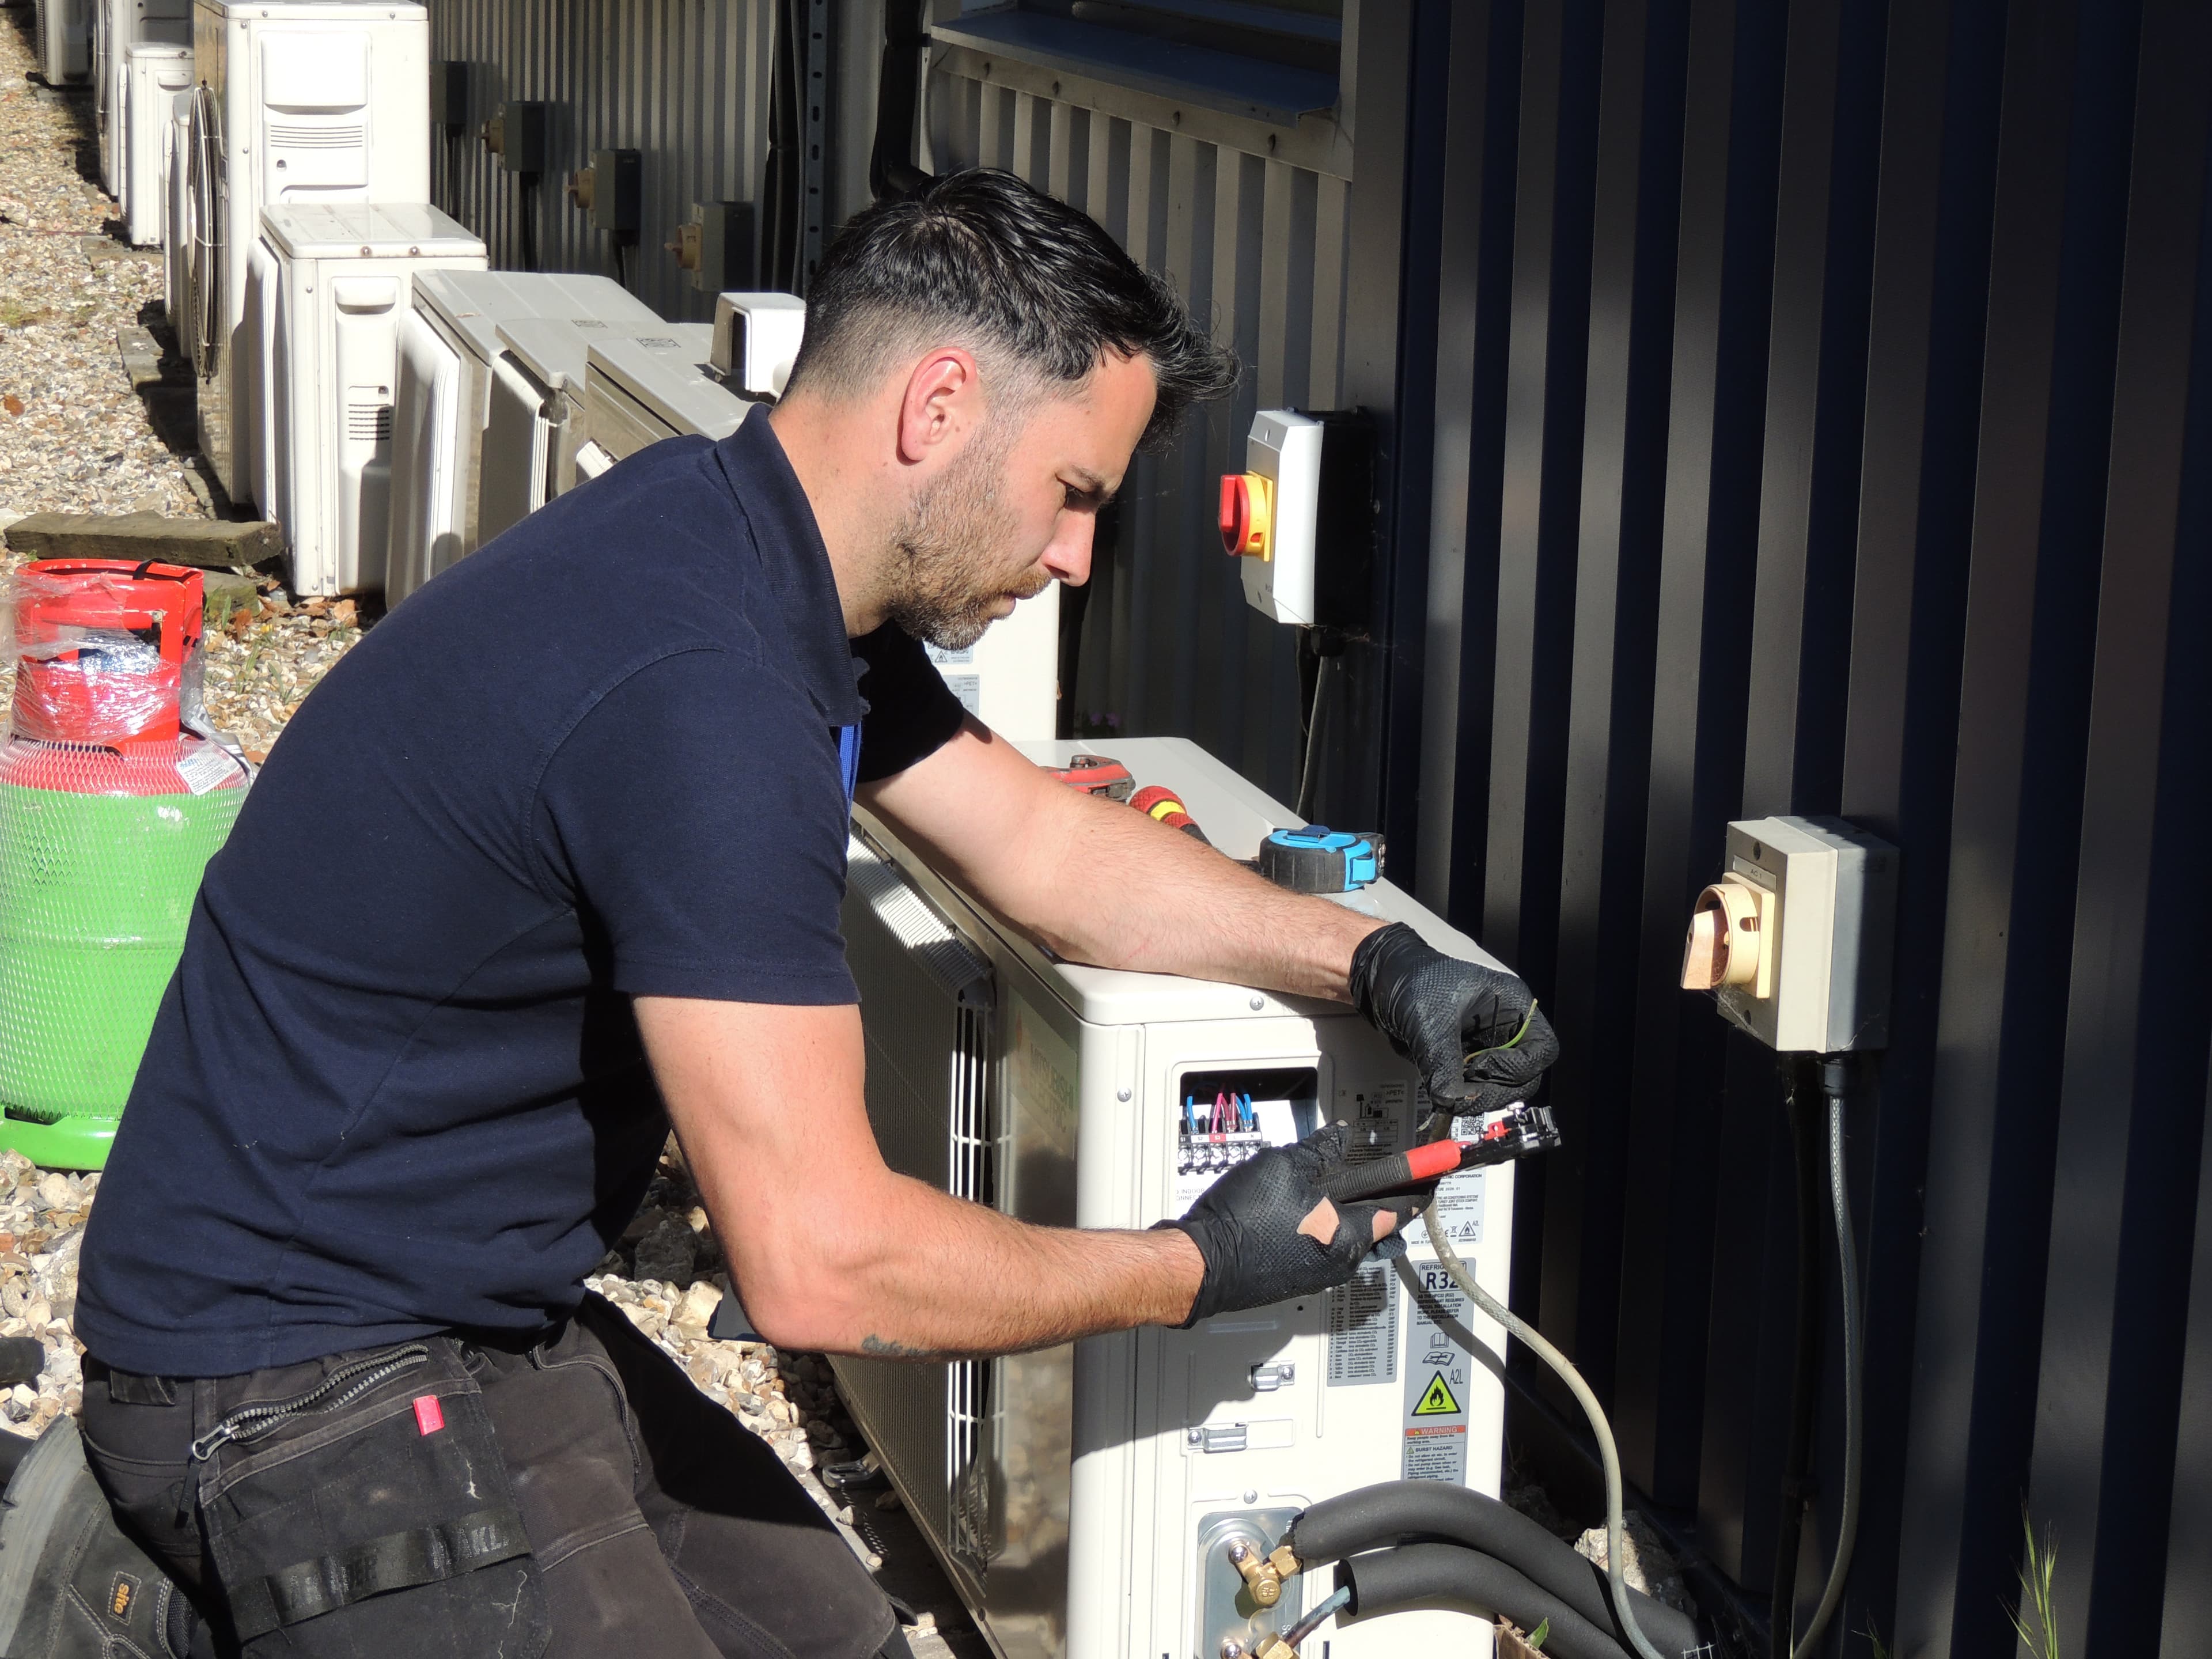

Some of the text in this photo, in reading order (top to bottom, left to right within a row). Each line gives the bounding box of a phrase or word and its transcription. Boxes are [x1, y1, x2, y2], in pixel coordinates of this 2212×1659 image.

[1421, 1263, 1466, 1271] REFRIGT
[1449, 1368, 1464, 1385] A2L
[1421, 1426, 1457, 1434] WARNING
[114, 1582, 130, 1614] site
